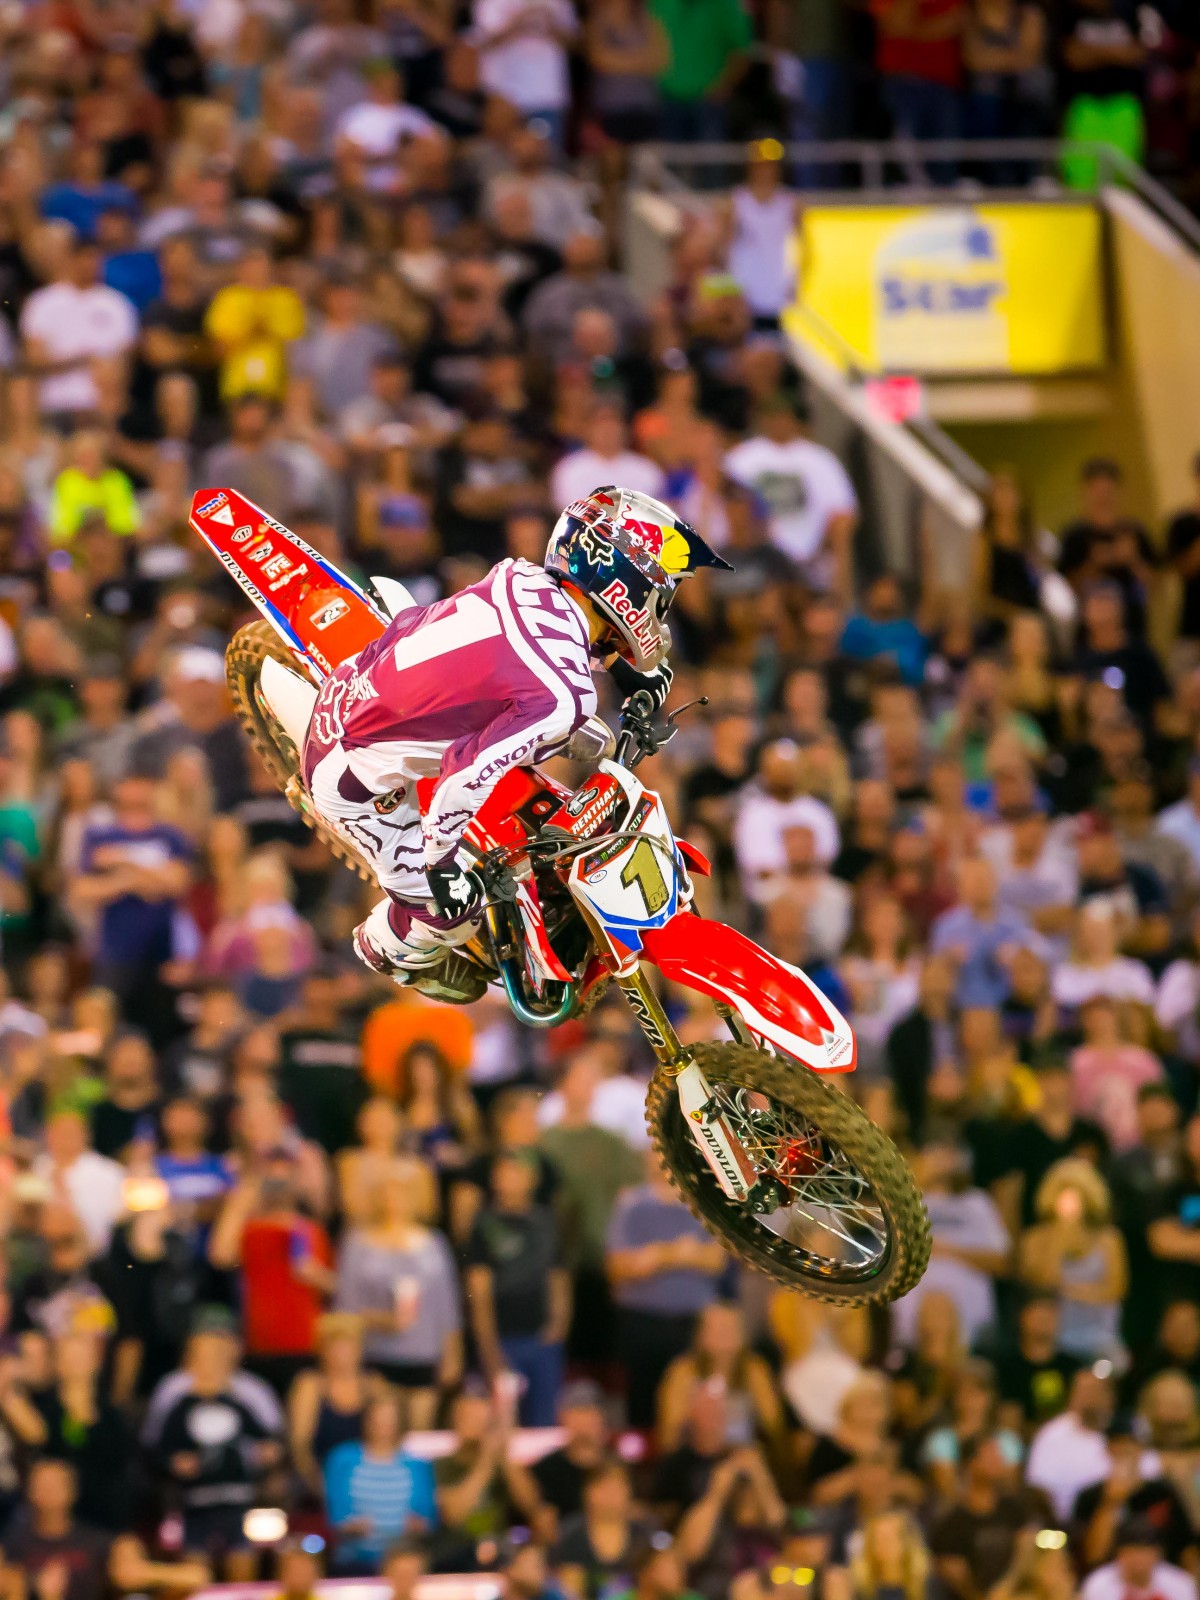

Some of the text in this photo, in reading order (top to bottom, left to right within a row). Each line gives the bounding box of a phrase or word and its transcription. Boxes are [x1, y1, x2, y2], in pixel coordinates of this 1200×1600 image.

[265, 519, 323, 562] DUNLOP
[220, 553, 266, 604] DUNLOP
[602, 580, 647, 625] Red
[307, 642, 334, 675] HON
[462, 732, 546, 791] HONDA
[571, 784, 616, 835] RENTHAL
[628, 813, 643, 832] CUP
[620, 836, 669, 918] 1
[830, 1042, 851, 1064] HONDA
